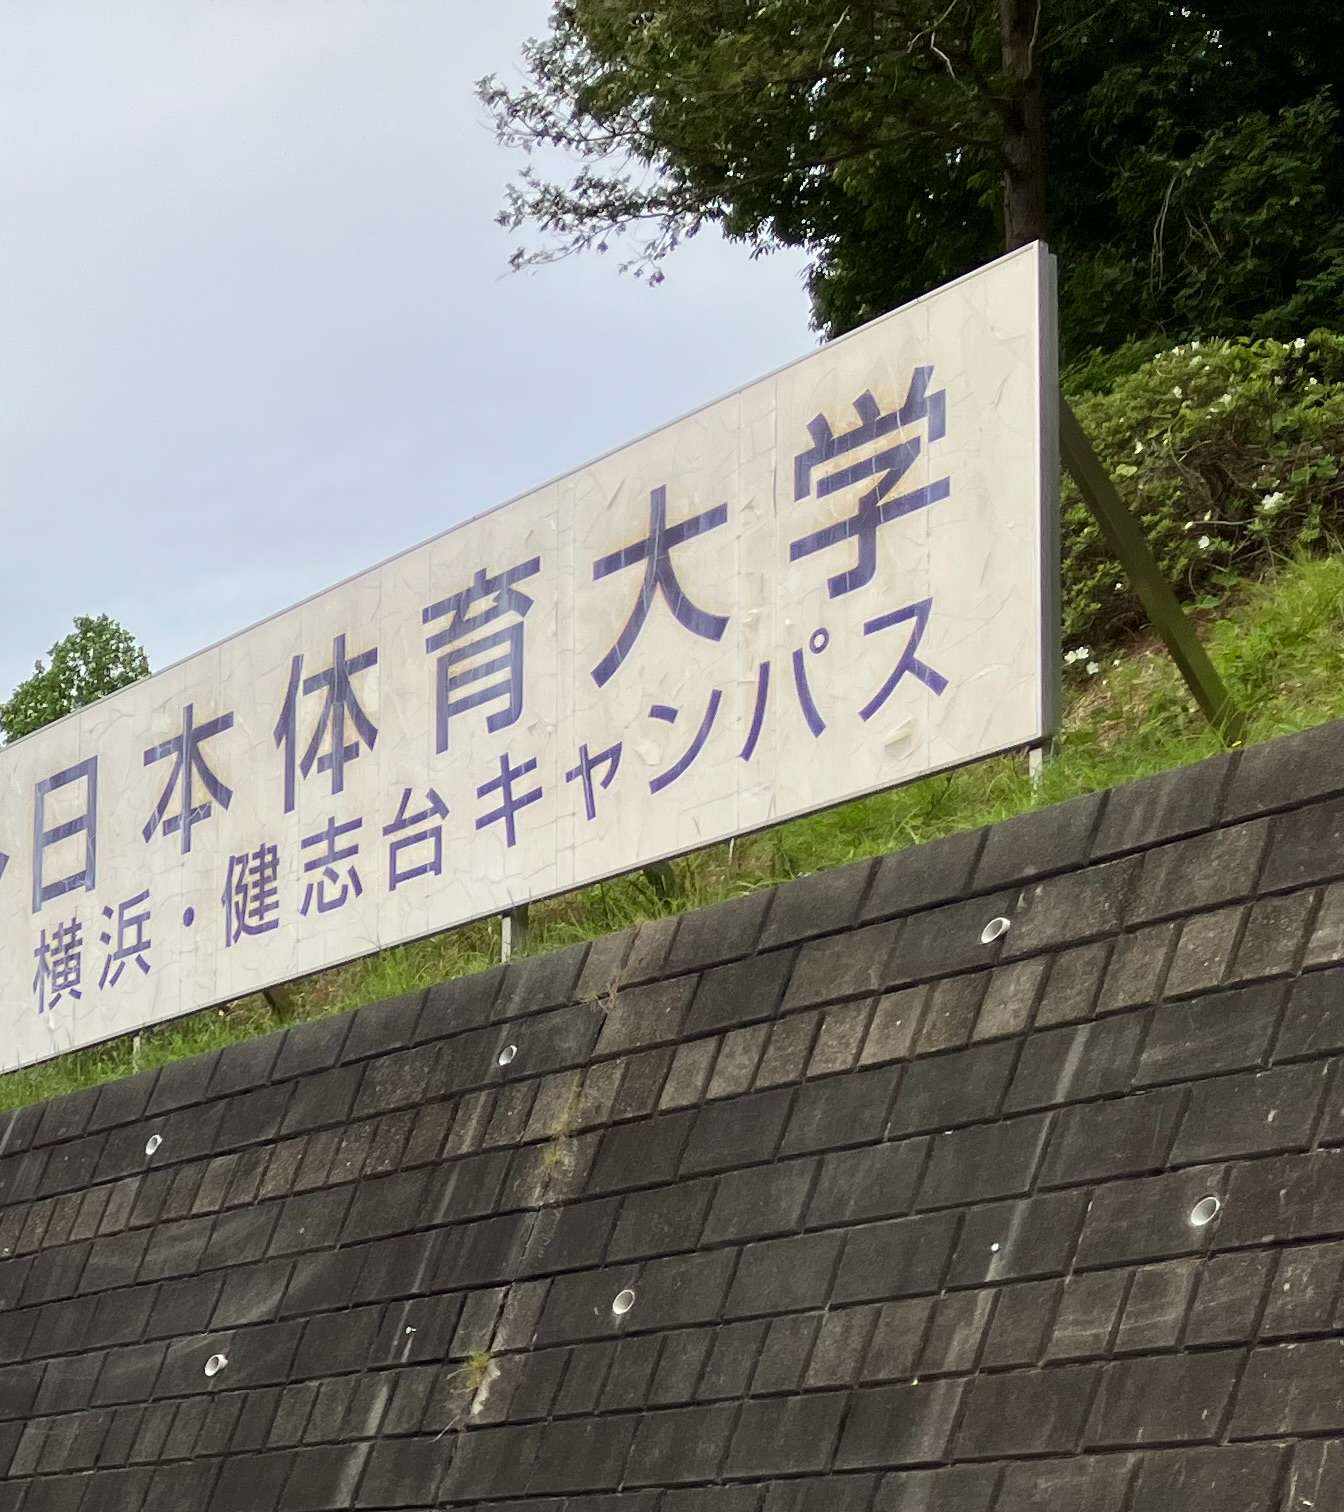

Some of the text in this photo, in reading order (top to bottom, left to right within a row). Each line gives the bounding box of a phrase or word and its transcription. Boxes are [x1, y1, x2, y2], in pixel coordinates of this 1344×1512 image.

[30, 365, 952, 914] 日本体育大学
[32, 594, 950, 1015] 横浜・健志台キャンパス
